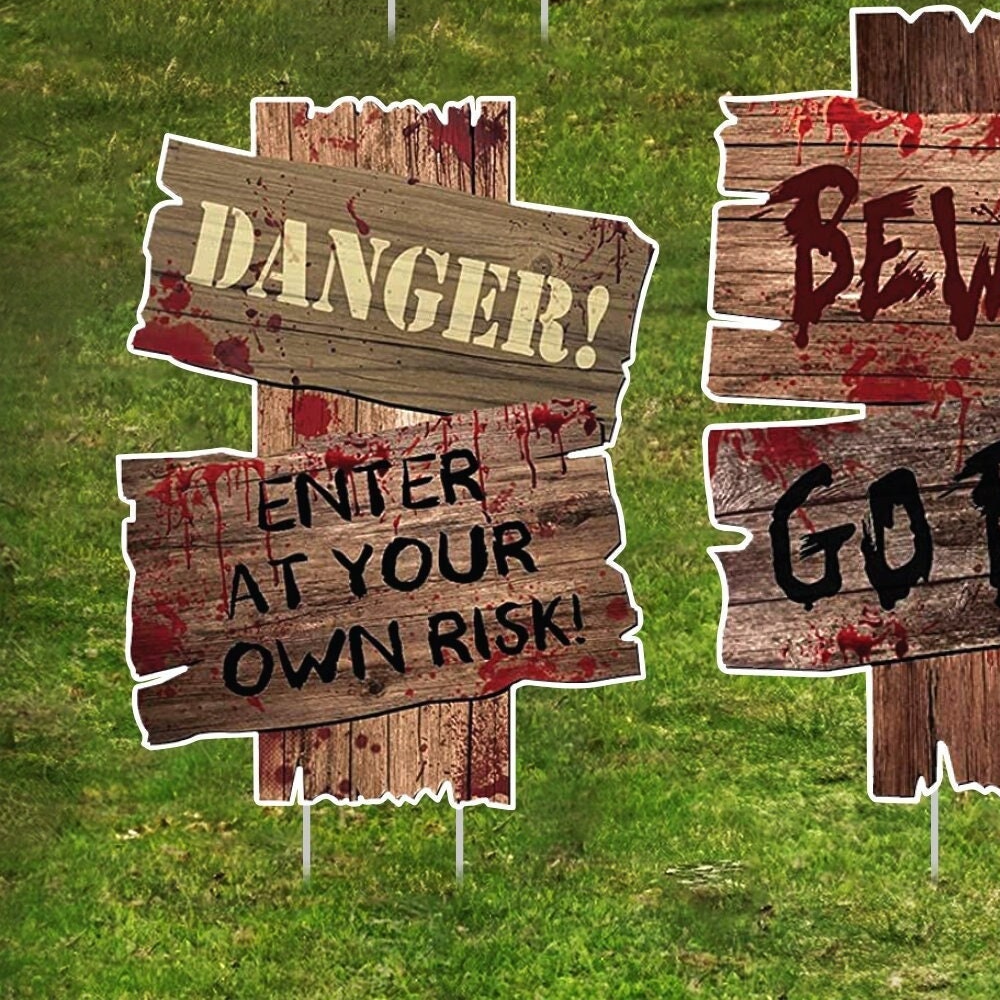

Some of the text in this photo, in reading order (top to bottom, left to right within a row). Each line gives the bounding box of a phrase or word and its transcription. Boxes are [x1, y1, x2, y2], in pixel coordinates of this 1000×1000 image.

[184, 200, 612, 370] DANGER!
[257, 448, 486, 533] ENTER
[769, 463, 934, 610] GO
[227, 519, 539, 620] AT YOUR
[223, 594, 585, 698] OWN RISK!
